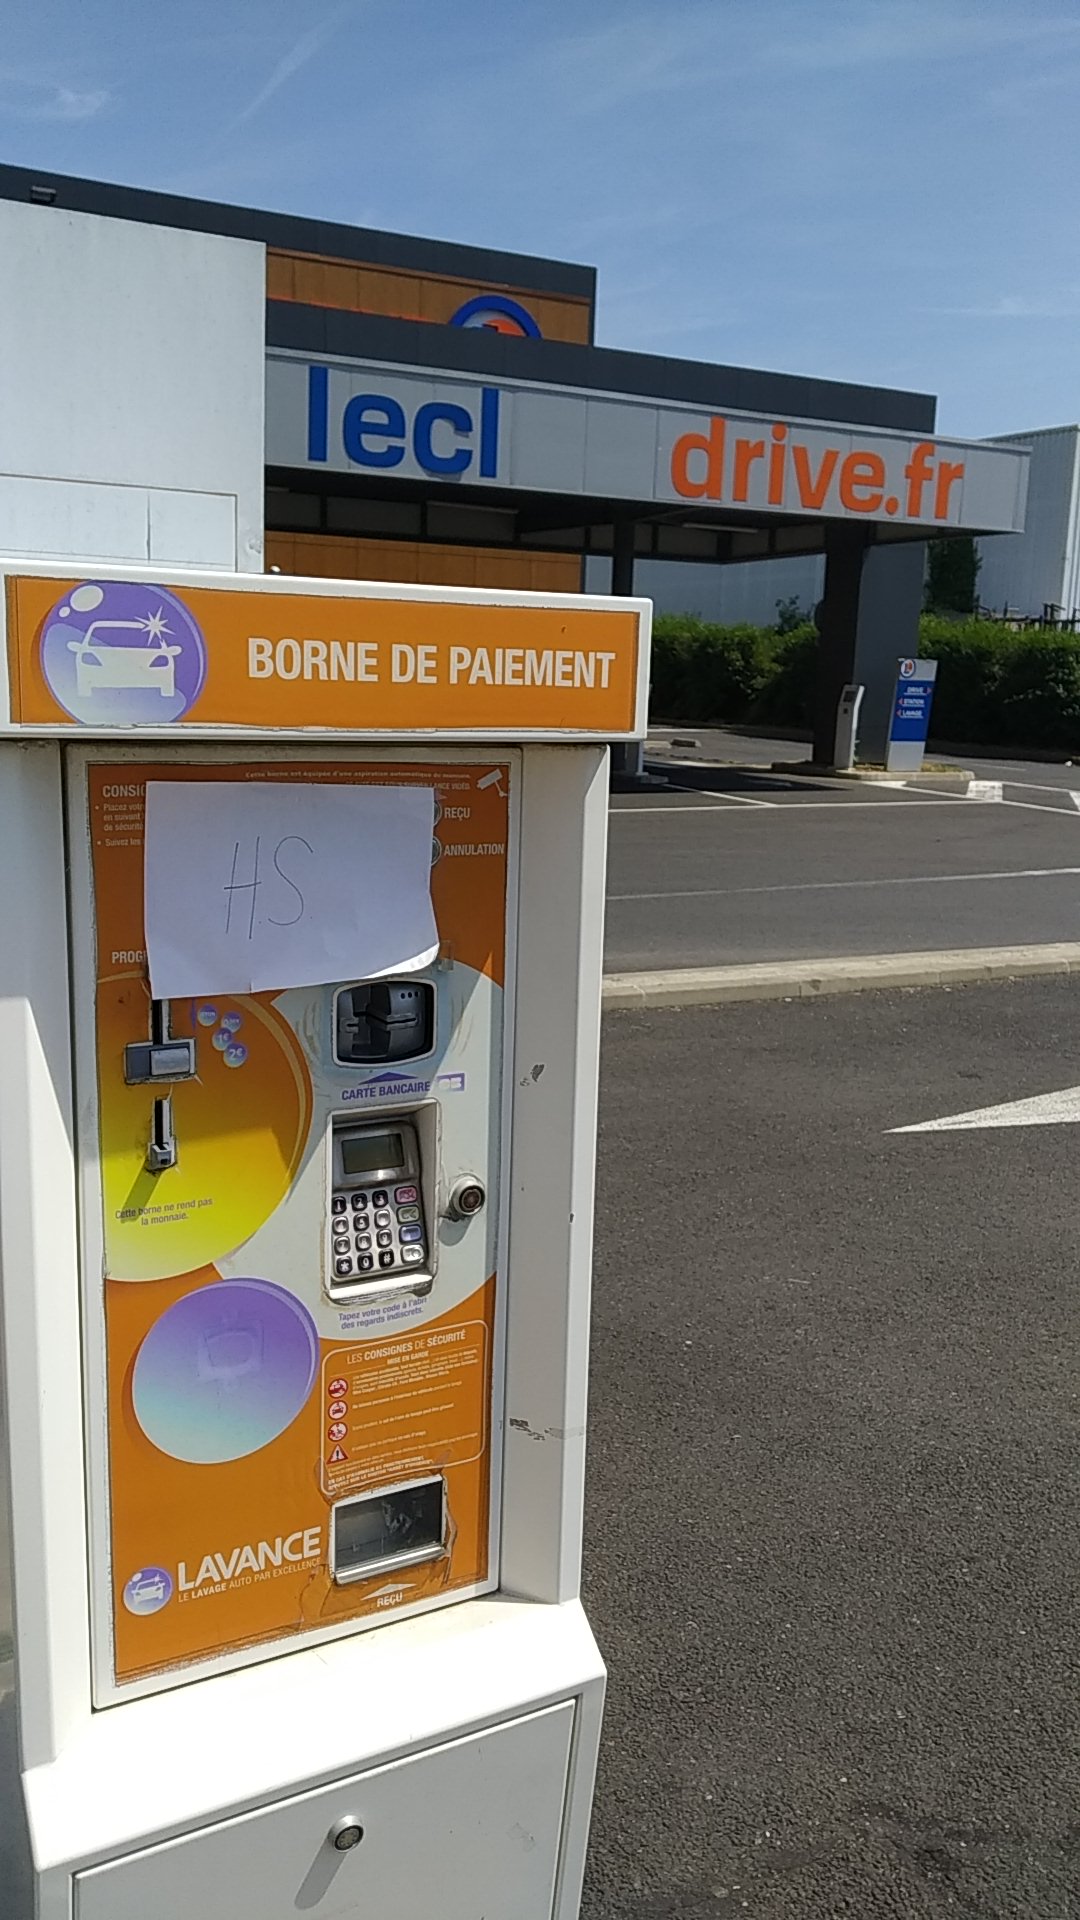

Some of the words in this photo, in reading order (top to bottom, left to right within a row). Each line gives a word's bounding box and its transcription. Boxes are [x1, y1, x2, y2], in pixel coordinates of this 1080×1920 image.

[308, 366, 500, 479] lecl
[670, 416, 965, 520] drive.fr
[248, 637, 378, 682] BORNE
[392, 643, 438, 684] DE
[449, 645, 616, 690] PAIEMENT
[444, 807, 470, 821] REÇU
[444, 843, 505, 857] ANNULATION
[229, 1047, 244, 1060] 2€
[341, 1087, 376, 1101] CARTE
[379, 1081, 431, 1097] BANCAIRE
[115, 1208, 137, 1219] Cette
[138, 1205, 162, 1216] borne
[164, 1203, 175, 1212] ne
[176, 1199, 196, 1210] rend
[197, 1197, 213, 1209] pas
[141, 1216, 149, 1226] la
[150, 1211, 189, 1225] monnaie.
[339, 1311, 361, 1322] Tapez
[361, 1307, 381, 1318] votre
[382, 1303, 401, 1313] code
[402, 1300, 407, 1309] à
[341, 1319, 355, 1330] des
[356, 1315, 385, 1327] regards
[347, 1352, 363, 1365] LES
[364, 1342, 413, 1361] CONSIGNES
[414, 1339, 426, 1350] DE
[427, 1329, 466, 1347] SÉCURITÉ
[402, 1354, 410, 1362] EN
[178, 1526, 322, 1592] LAVANCE
[178, 1592, 190, 1603] LE
[191, 1582, 227, 1599] LAVAGE
[229, 1575, 252, 1590] AUTO
[254, 1570, 271, 1583] PAR
[272, 1557, 321, 1578] EXCELLENCE
[376, 1591, 403, 1608] REÇU
